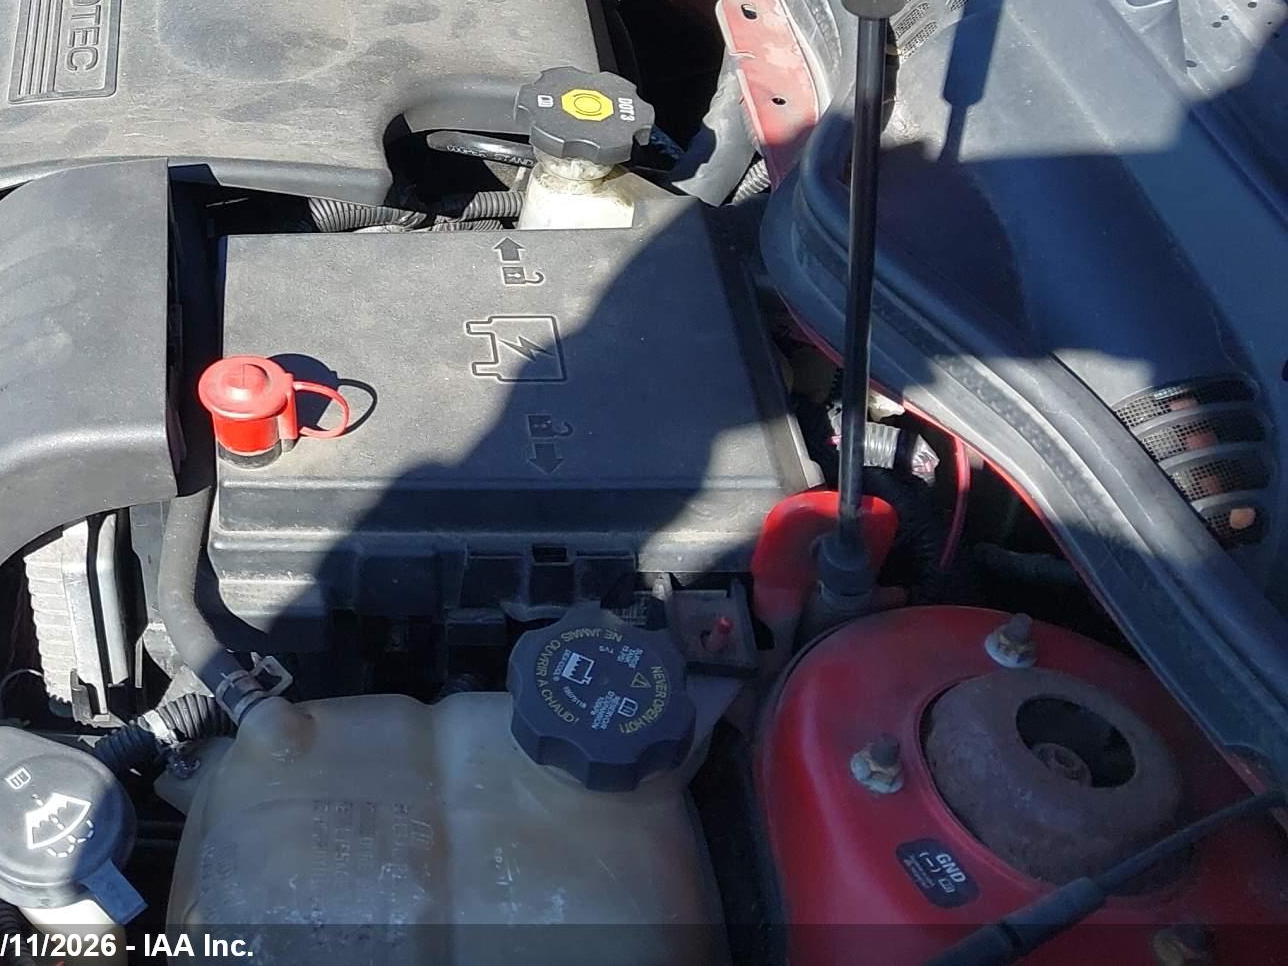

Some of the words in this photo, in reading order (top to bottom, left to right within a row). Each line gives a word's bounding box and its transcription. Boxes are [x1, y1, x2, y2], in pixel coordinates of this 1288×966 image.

[560, 628, 601, 642] JAMAIS
[603, 628, 623, 643] NE
[535, 639, 561, 677] OUVRIR
[650, 665, 668, 700] NEVER
[643, 699, 666, 725] OPEN
[935, 852, 967, 883] GND
